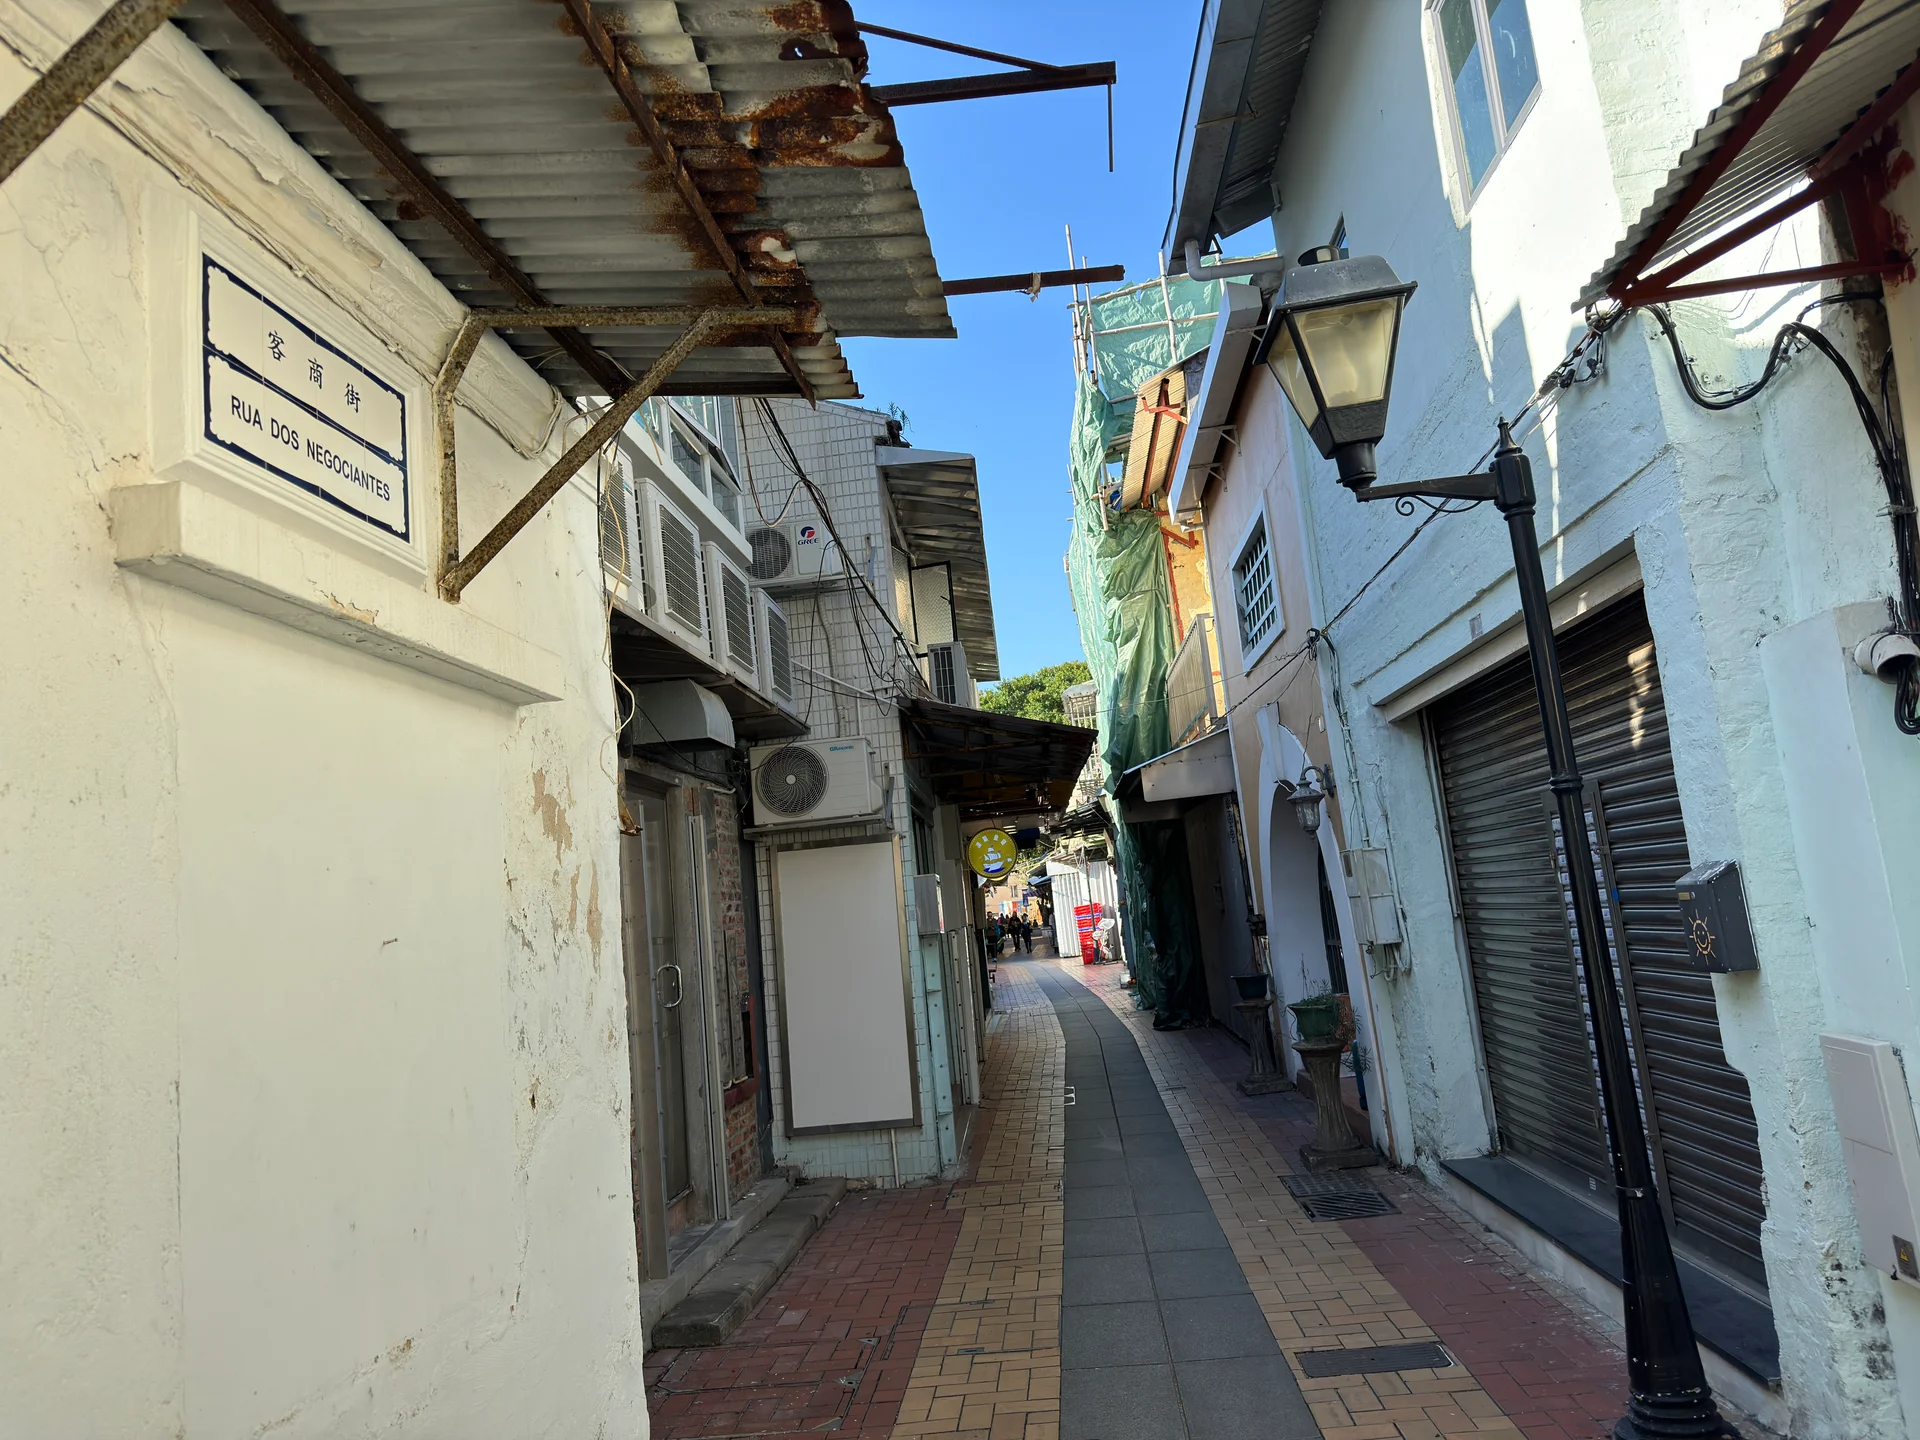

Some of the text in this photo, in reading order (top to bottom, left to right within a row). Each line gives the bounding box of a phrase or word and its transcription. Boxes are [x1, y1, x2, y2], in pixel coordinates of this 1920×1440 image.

[268, 330, 361, 413] 客商街
[231, 395, 390, 502] RUA DOS NEGOCIANTES
